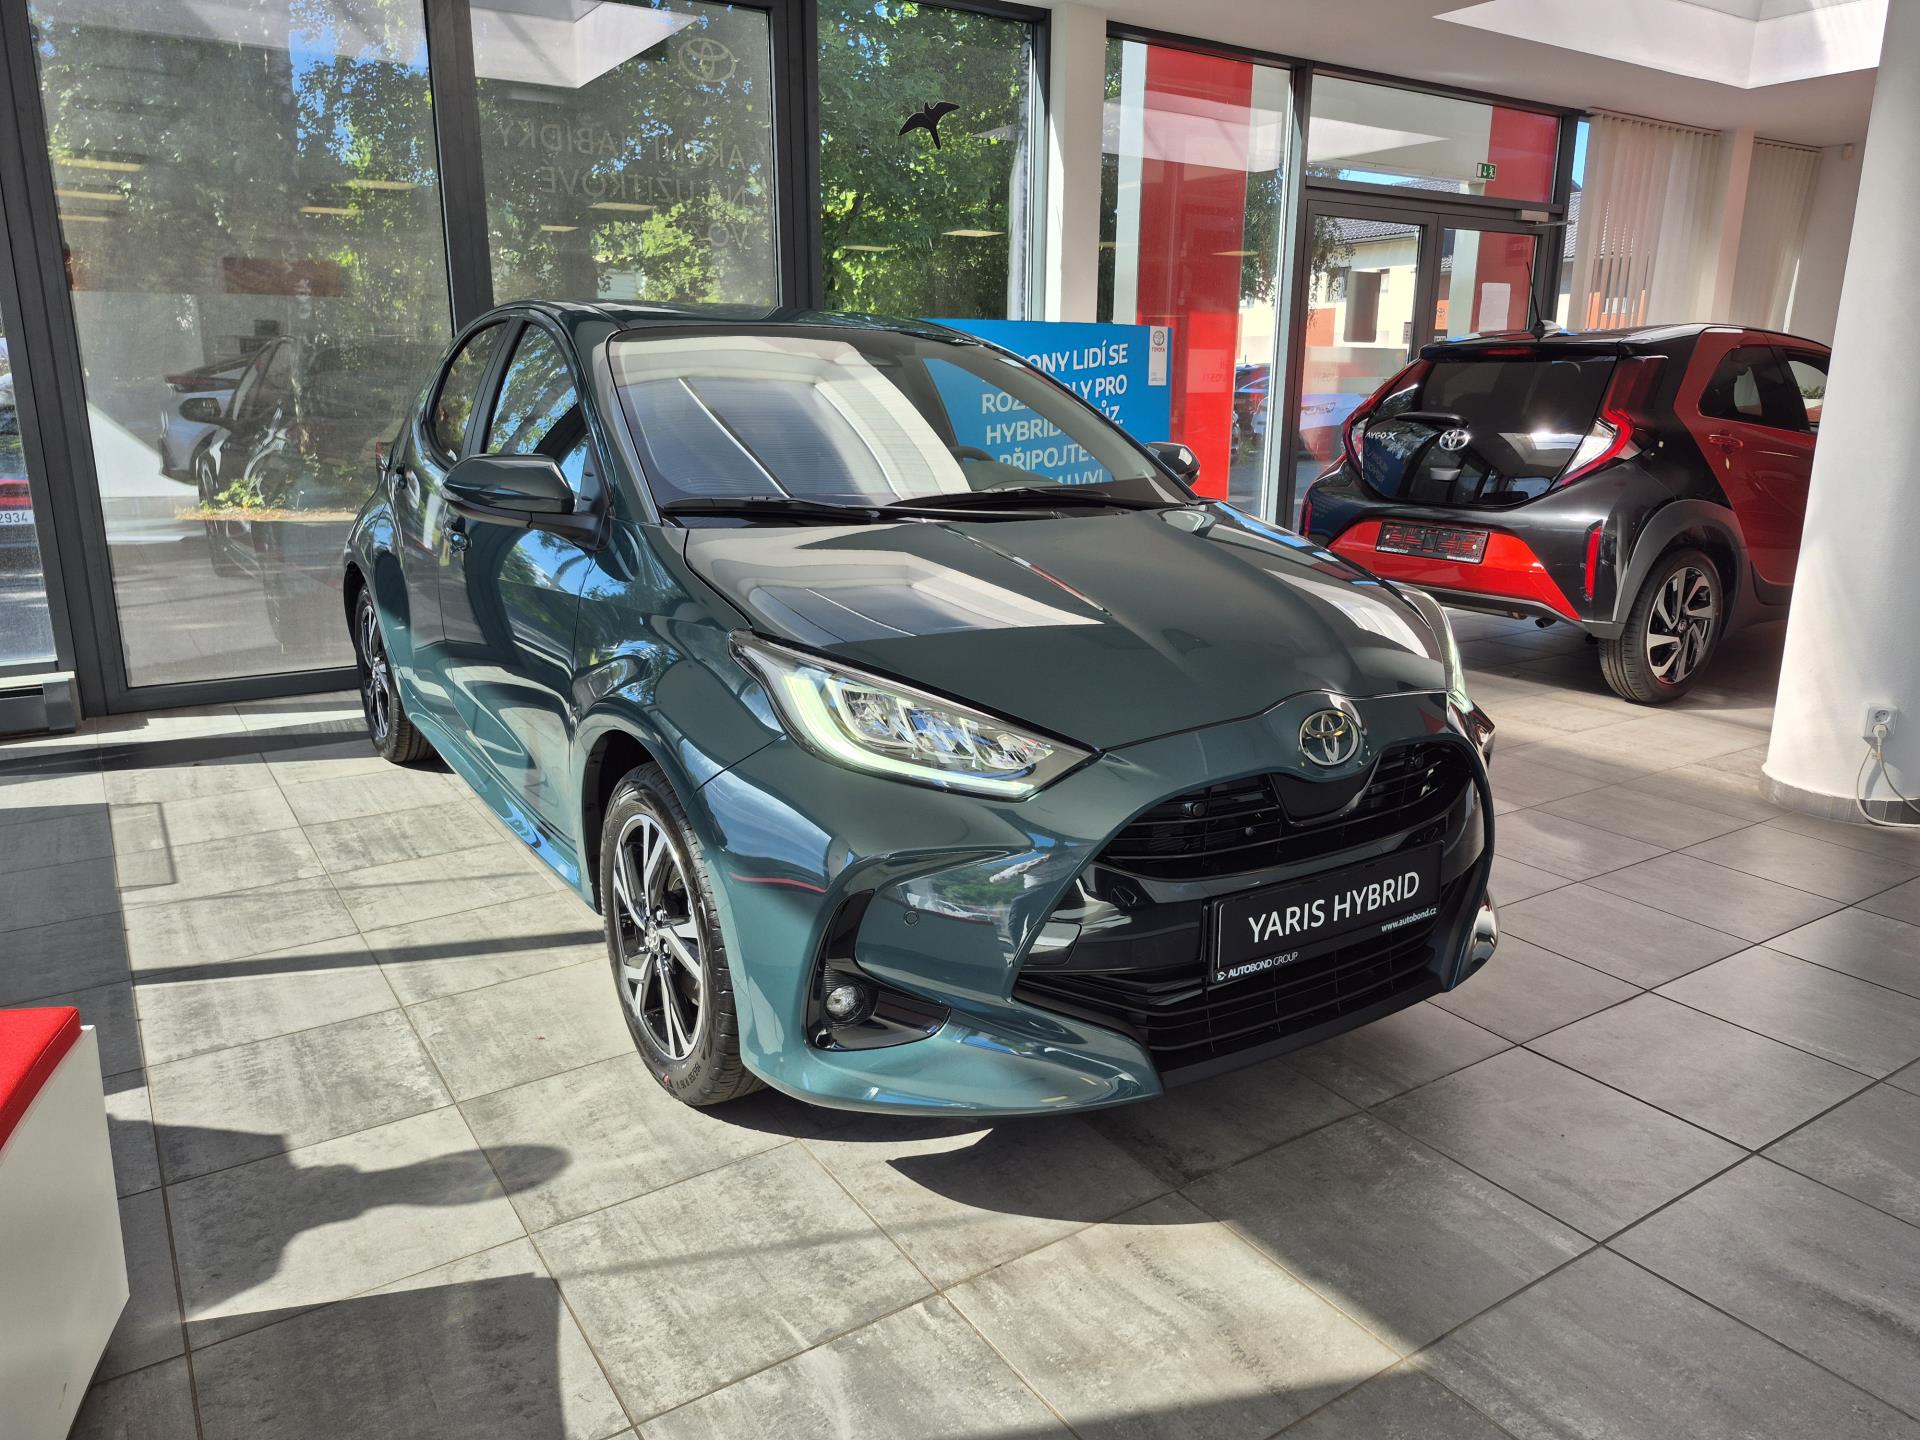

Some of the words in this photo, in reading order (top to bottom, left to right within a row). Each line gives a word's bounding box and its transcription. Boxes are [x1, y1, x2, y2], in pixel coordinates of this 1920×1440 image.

[1073, 339, 1107, 371] LIDÍ
[1109, 343, 1129, 367] SE
[1095, 374, 1128, 399] PRO
[1248, 899, 1325, 944] YARIS
[1333, 871, 1420, 922] HYBRID
[1381, 907, 1438, 933] www.autobond.cz
[1228, 959, 1272, 979] AUTOBOND
[1273, 951, 1299, 966] GROUP
